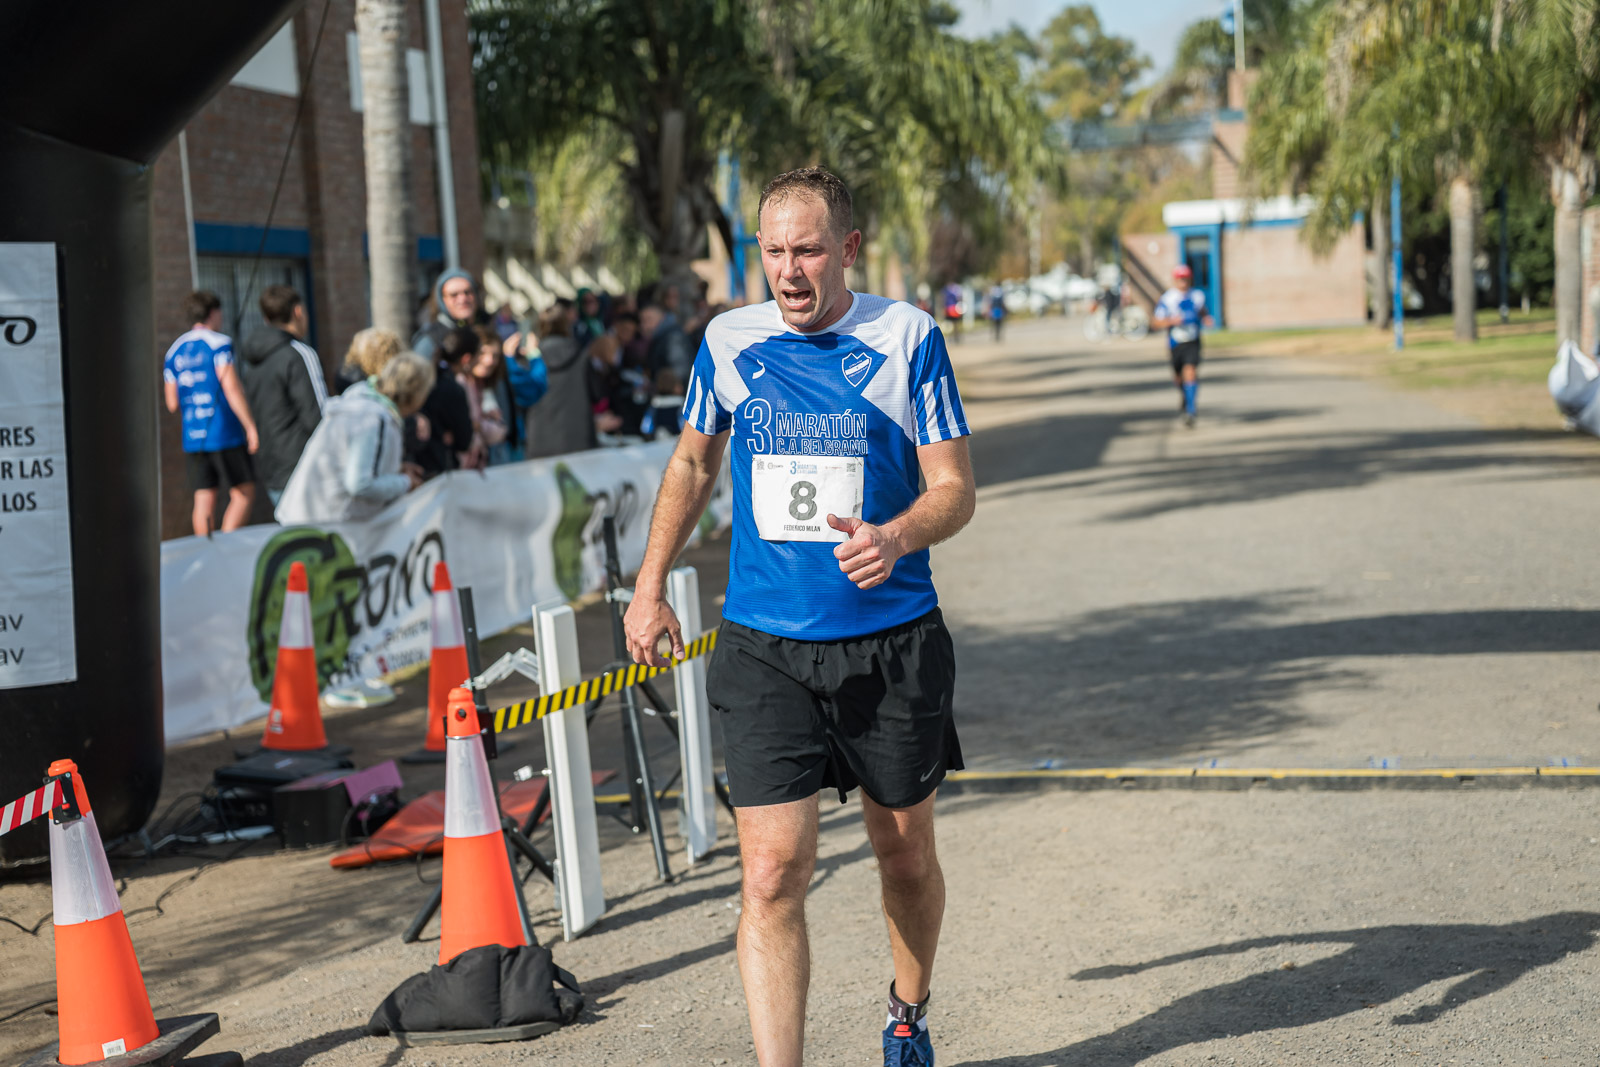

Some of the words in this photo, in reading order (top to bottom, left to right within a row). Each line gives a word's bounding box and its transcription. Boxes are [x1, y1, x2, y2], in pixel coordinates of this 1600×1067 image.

[744, 398, 773, 455] 3
[775, 408, 867, 439] MARATÓN
[19, 458, 54, 479] LAS
[789, 460, 798, 475] 3
[2, 491, 37, 513] LOS
[788, 480, 818, 521] 8
[783, 524, 806, 532] FEDERICO
